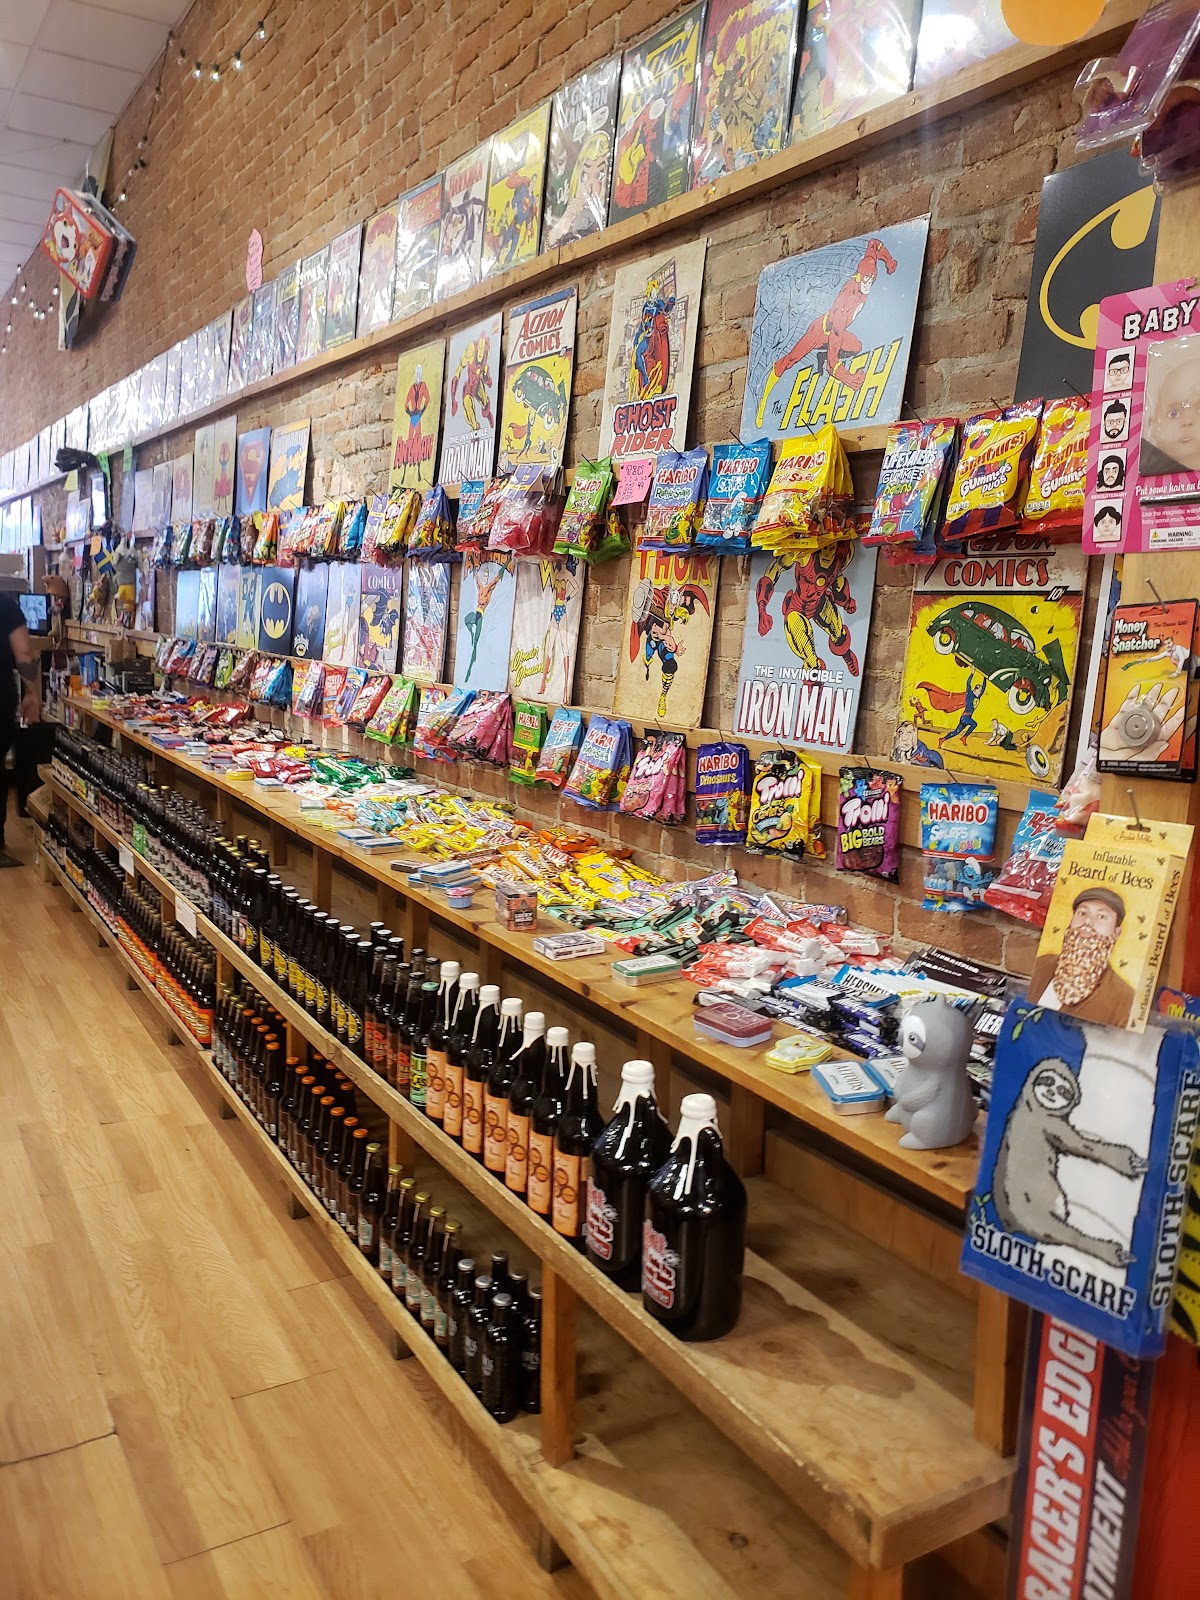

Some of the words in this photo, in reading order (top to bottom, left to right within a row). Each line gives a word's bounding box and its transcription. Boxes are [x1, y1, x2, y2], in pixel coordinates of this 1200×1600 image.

[1122, 298, 1198, 340] BABY
[519, 331, 561, 360] COMICS
[779, 338, 903, 430] FLASH
[613, 398, 676, 437] GHOST
[610, 428, 673, 459] RIDER
[441, 443, 468, 485] IRON
[467, 438, 493, 481] MAN
[656, 466, 698, 485] HARIBO
[1135, 485, 1148, 496] Put
[1150, 484, 1168, 495] some
[1169, 481, 1185, 493] hair
[944, 559, 1050, 587] COMICS
[1115, 618, 1147, 637] Money
[511, 646, 540, 671] Wonder
[754, 665, 774, 679] THE
[778, 667, 844, 685] INVINCIBLE
[737, 680, 798, 738] IRON
[793, 684, 854, 747] MAN
[698, 753, 739, 774] HARIBO
[699, 773, 737, 786] Dinosaurs
[756, 769, 805, 804] Trolli
[842, 792, 890, 829] Trolli
[928, 802, 989, 825] HARIBO
[840, 829, 863, 853] BIG
[862, 827, 885, 838] BOLD
[862, 836, 885, 847] BEARS
[1092, 850, 1138, 868] Inflatable
[1068, 861, 1108, 882] Beard
[1108, 872, 1119, 884] of
[1121, 872, 1154, 891] Bees
[1148, 922, 1168, 968] Beard
[1166, 869, 1181, 905] Bees
[1167, 1068, 1200, 1187] SCARF
[1151, 1192, 1186, 1310] SLOTH
[971, 1221, 1046, 1279] SLOTH
[1048, 1256, 1138, 1320] SCARF
[1041, 1320, 1100, 1438] EDG
